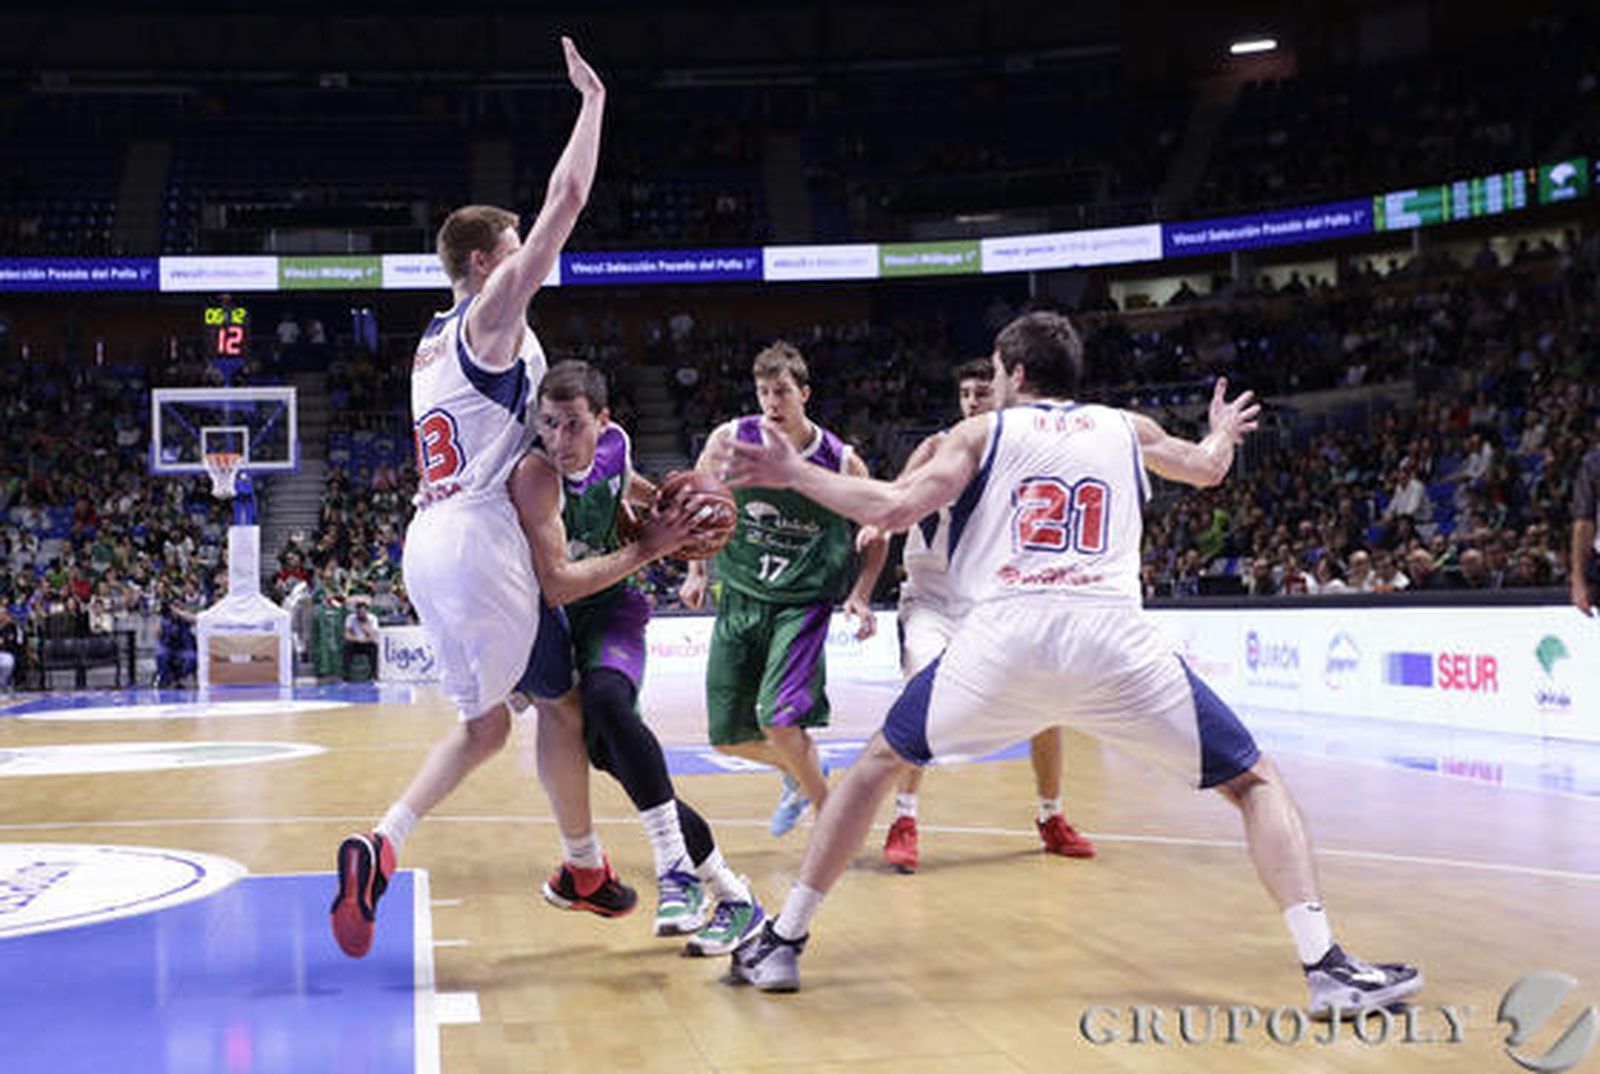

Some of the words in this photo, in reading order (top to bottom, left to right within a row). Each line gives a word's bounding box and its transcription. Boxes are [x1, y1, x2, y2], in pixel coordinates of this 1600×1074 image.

[218, 326, 244, 354] 12
[1011, 476, 1112, 554] 21
[757, 552, 790, 583] 17
[1438, 651, 1498, 694] SEUR
